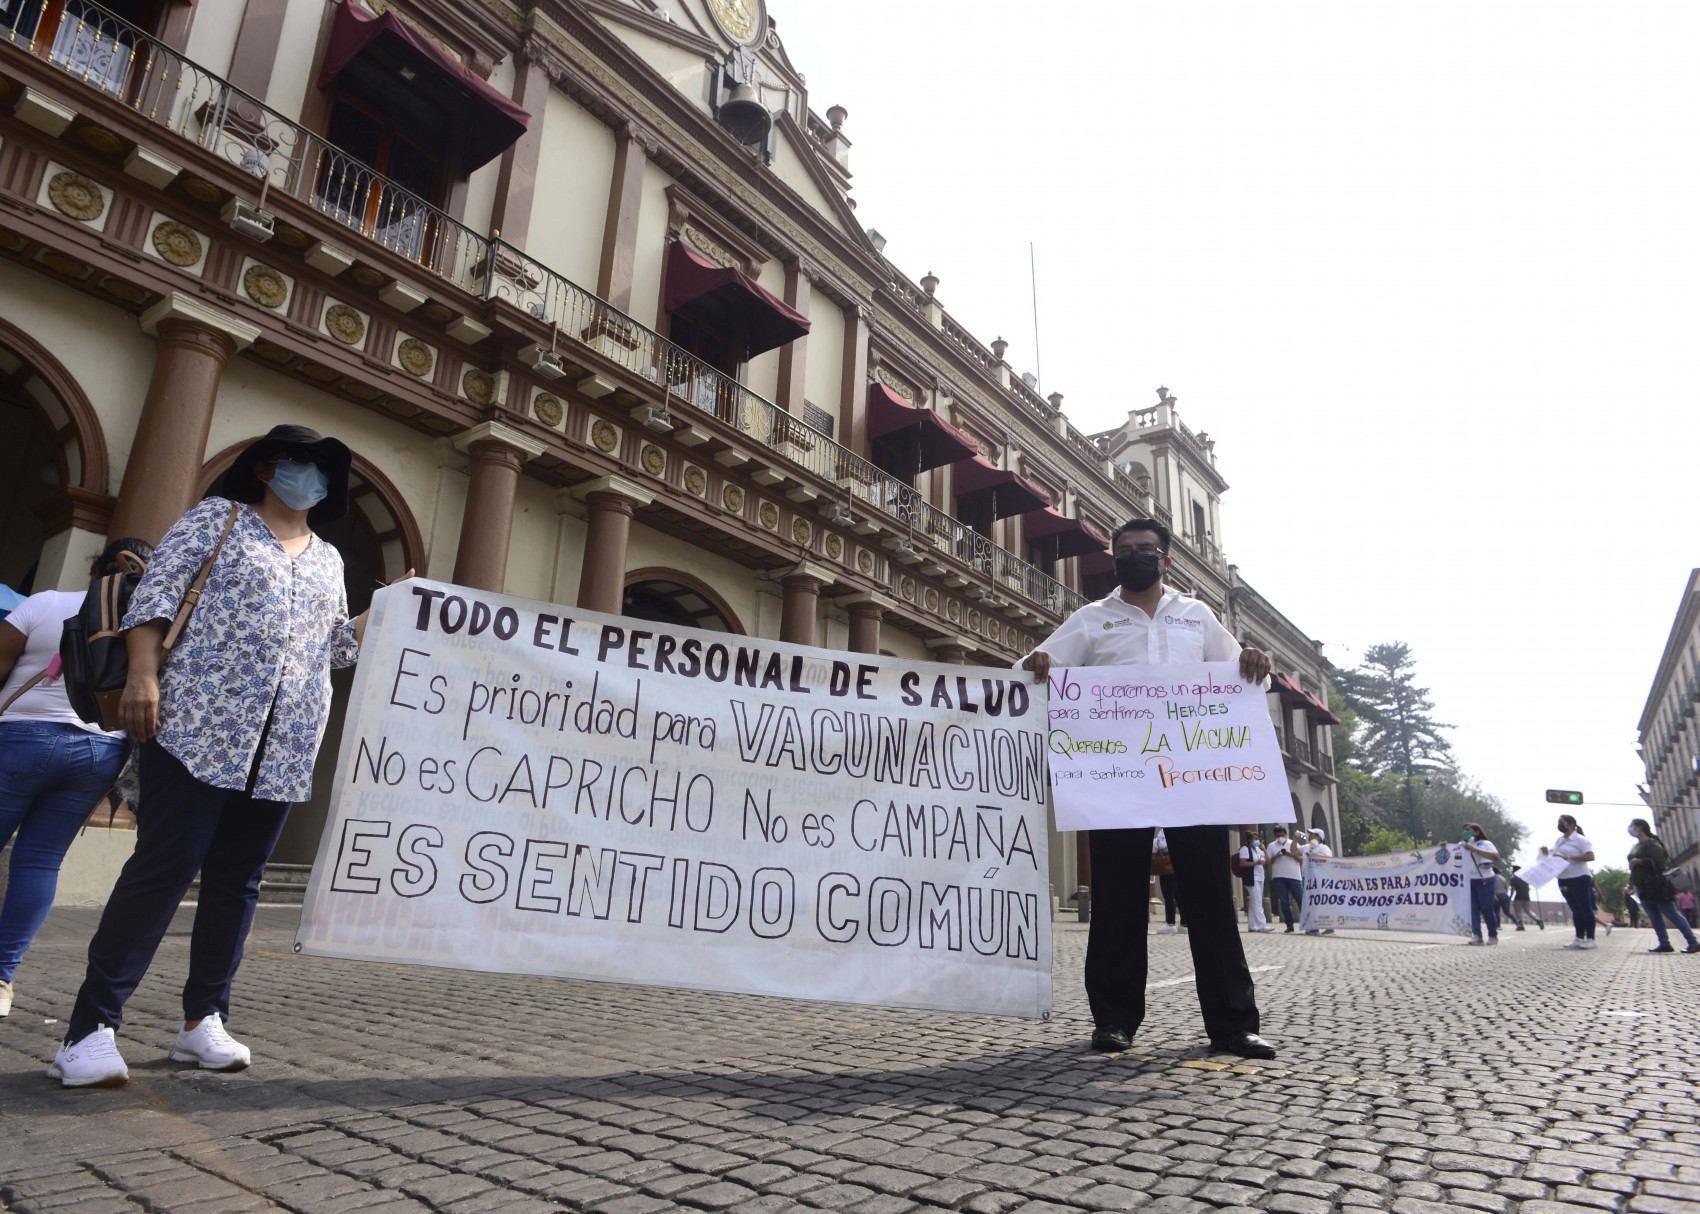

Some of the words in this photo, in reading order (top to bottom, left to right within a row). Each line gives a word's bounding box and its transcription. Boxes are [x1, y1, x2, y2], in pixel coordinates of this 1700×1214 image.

[412, 587, 519, 640] TODO
[533, 613, 579, 656] EL
[597, 625, 811, 693] PERSONAL
[830, 661, 879, 700] DE
[900, 671, 1029, 717] SALUD
[1092, 684, 1168, 708] queremos
[1172, 684, 1188, 696] un
[1191, 672, 1243, 705] aplauso
[390, 647, 447, 714] Es
[463, 671, 640, 740] prioridad
[650, 707, 717, 763] para
[730, 700, 1044, 804] VACUNACION
[1048, 709, 1080, 731] para
[1141, 721, 1172, 755] LA
[1181, 720, 1252, 752] VACUNA
[1055, 768, 1083, 786] para
[1145, 755, 1266, 789] PROTEGIDOS
[353, 736, 406, 786] No
[419, 756, 457, 795] es
[466, 747, 714, 832] CAPRICHO
[743, 788, 788, 843] No
[802, 813, 836, 849] es
[851, 799, 1038, 870] CAMPAÑA
[330, 818, 443, 898] ES
[459, 831, 795, 939] SENTIDO
[816, 867, 1038, 960] COMÚN
[1308, 894, 1346, 906] TODOS
[1347, 894, 1395, 907] SOMOS
[1395, 892, 1448, 906] SALUD
[1321, 878, 1364, 891] VACUNA
[1366, 877, 1379, 891] ES
[1380, 876, 1411, 890] PARA
[1414, 873, 1465, 887] TODOS!
